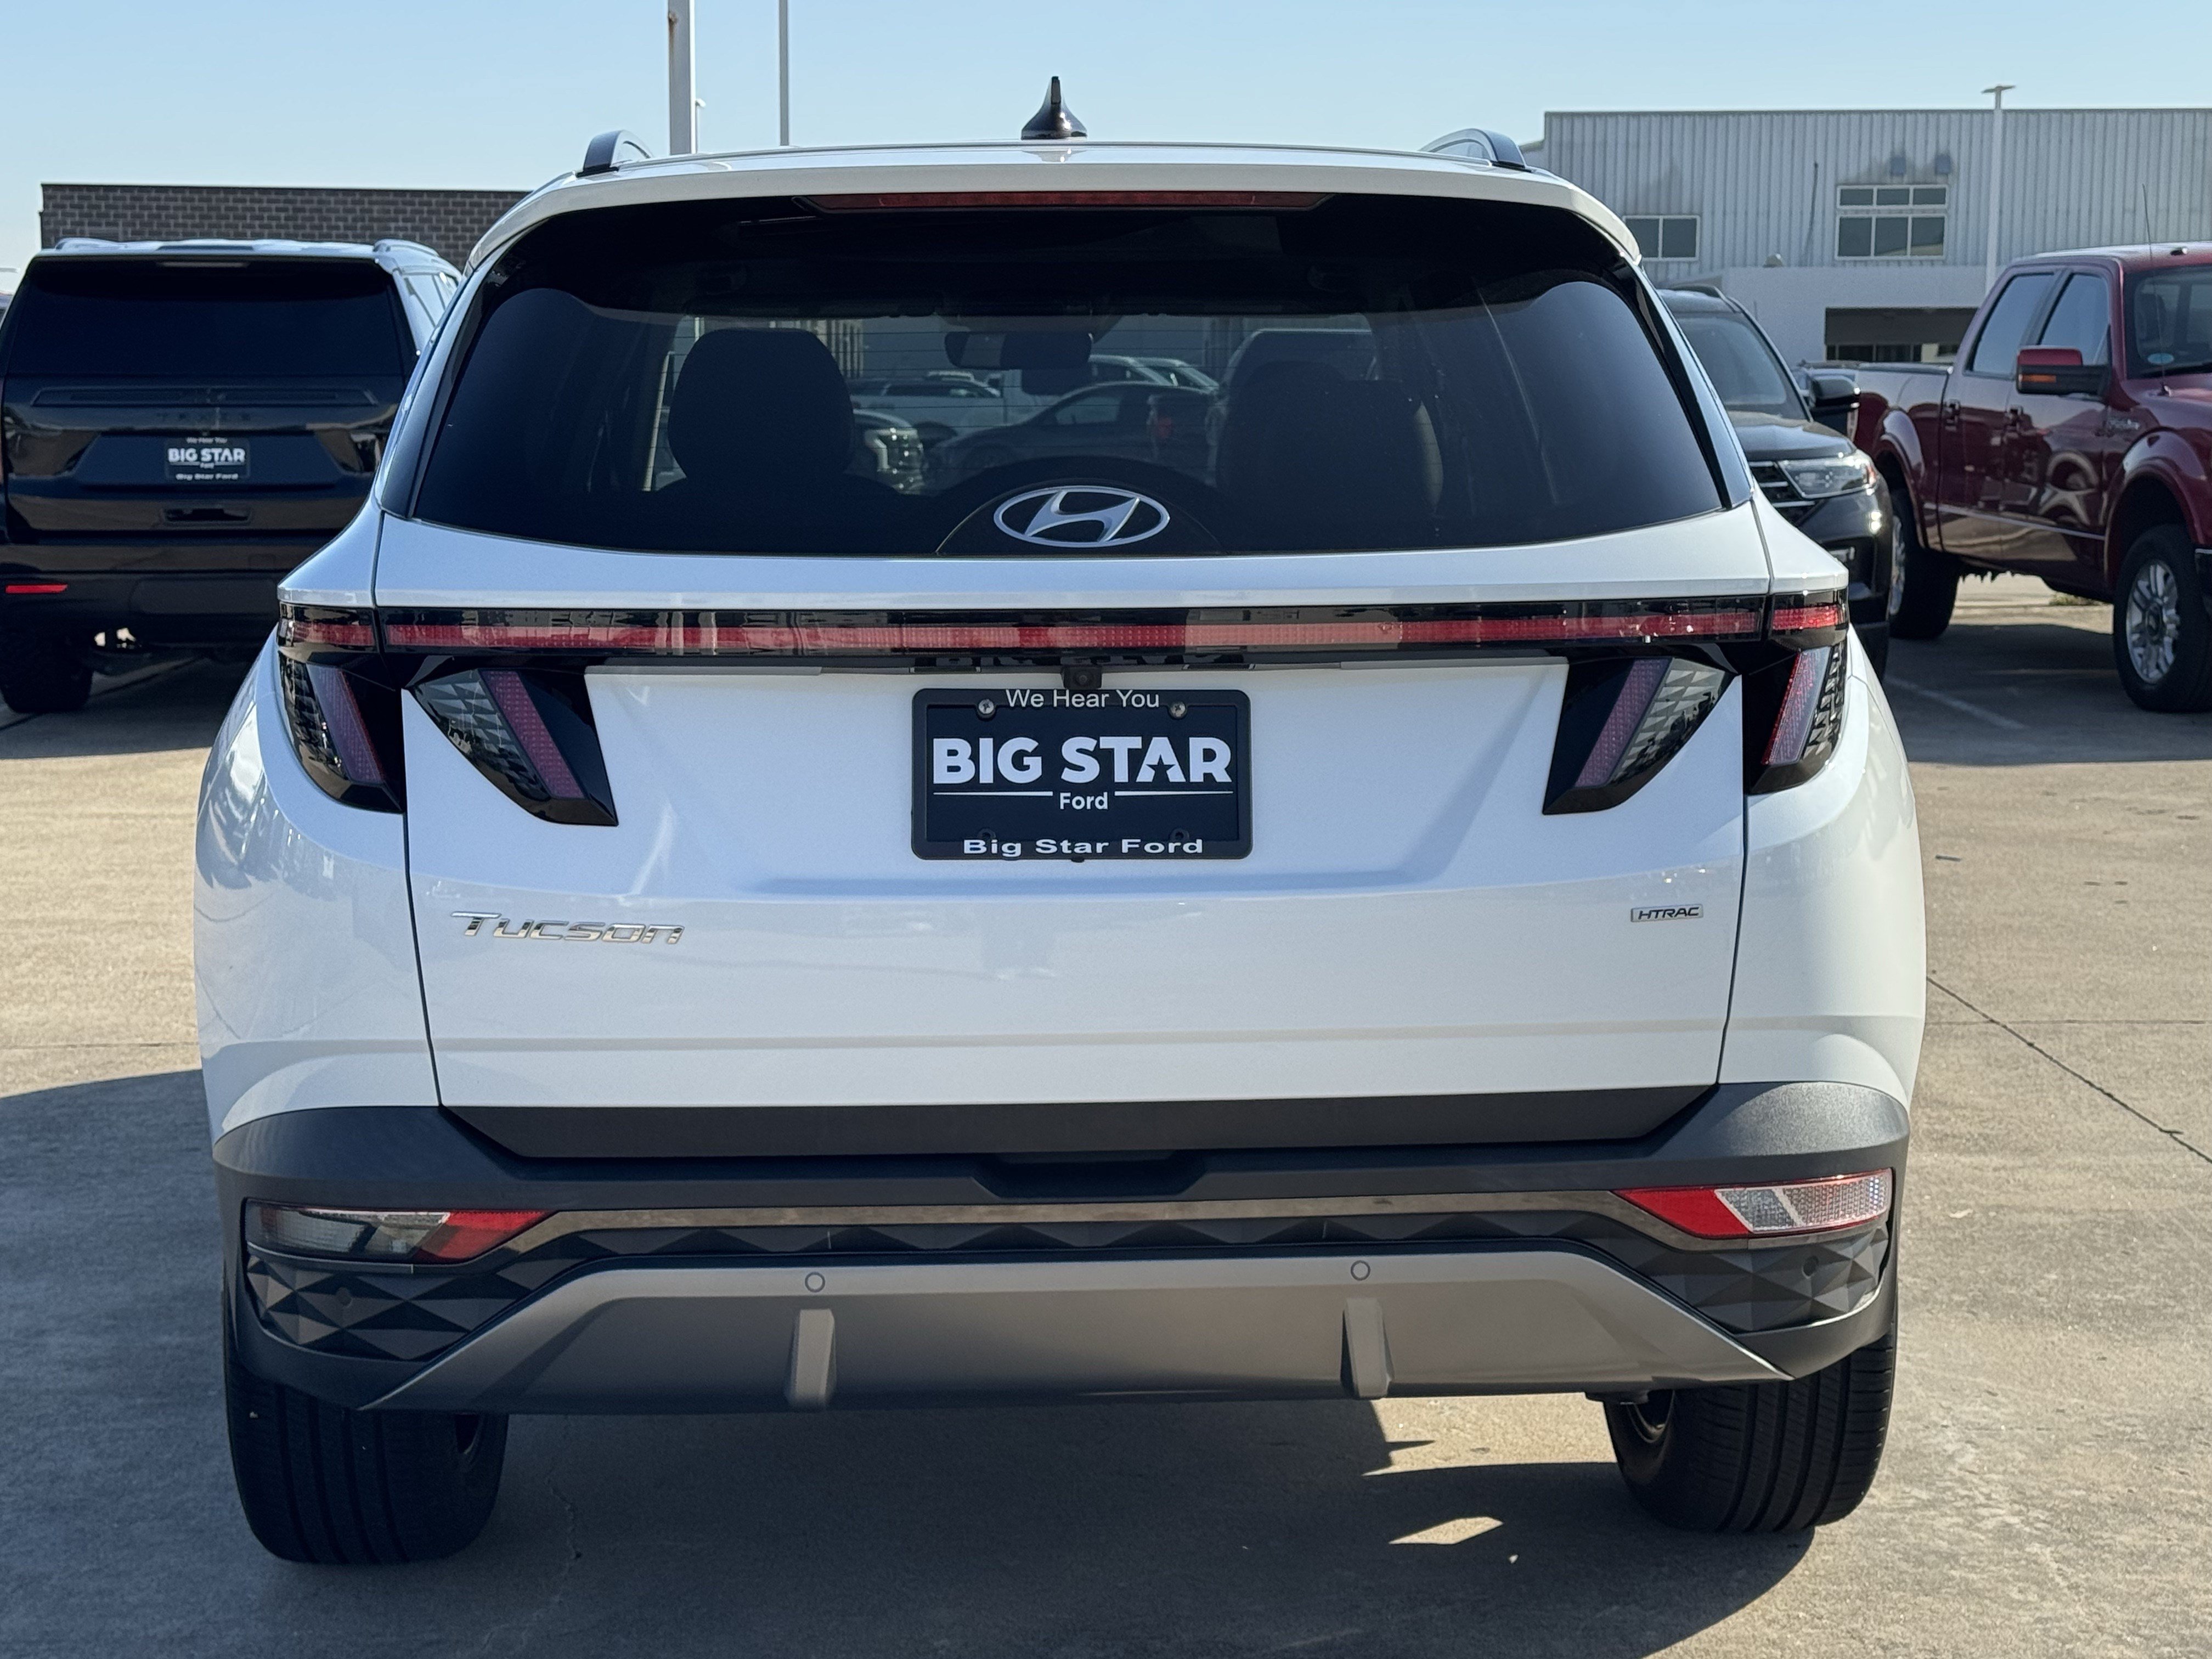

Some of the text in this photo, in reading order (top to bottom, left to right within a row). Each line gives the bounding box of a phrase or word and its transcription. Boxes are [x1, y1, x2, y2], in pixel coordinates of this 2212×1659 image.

[168, 448, 245, 462] BIG STAR
[1006, 689, 1160, 708] We Hear You
[933, 736, 1232, 785] BIG STAR
[1060, 792, 1108, 810] Ford
[963, 839, 1203, 857] Big Star Ford
[1638, 906, 1700, 920] HTRAC
